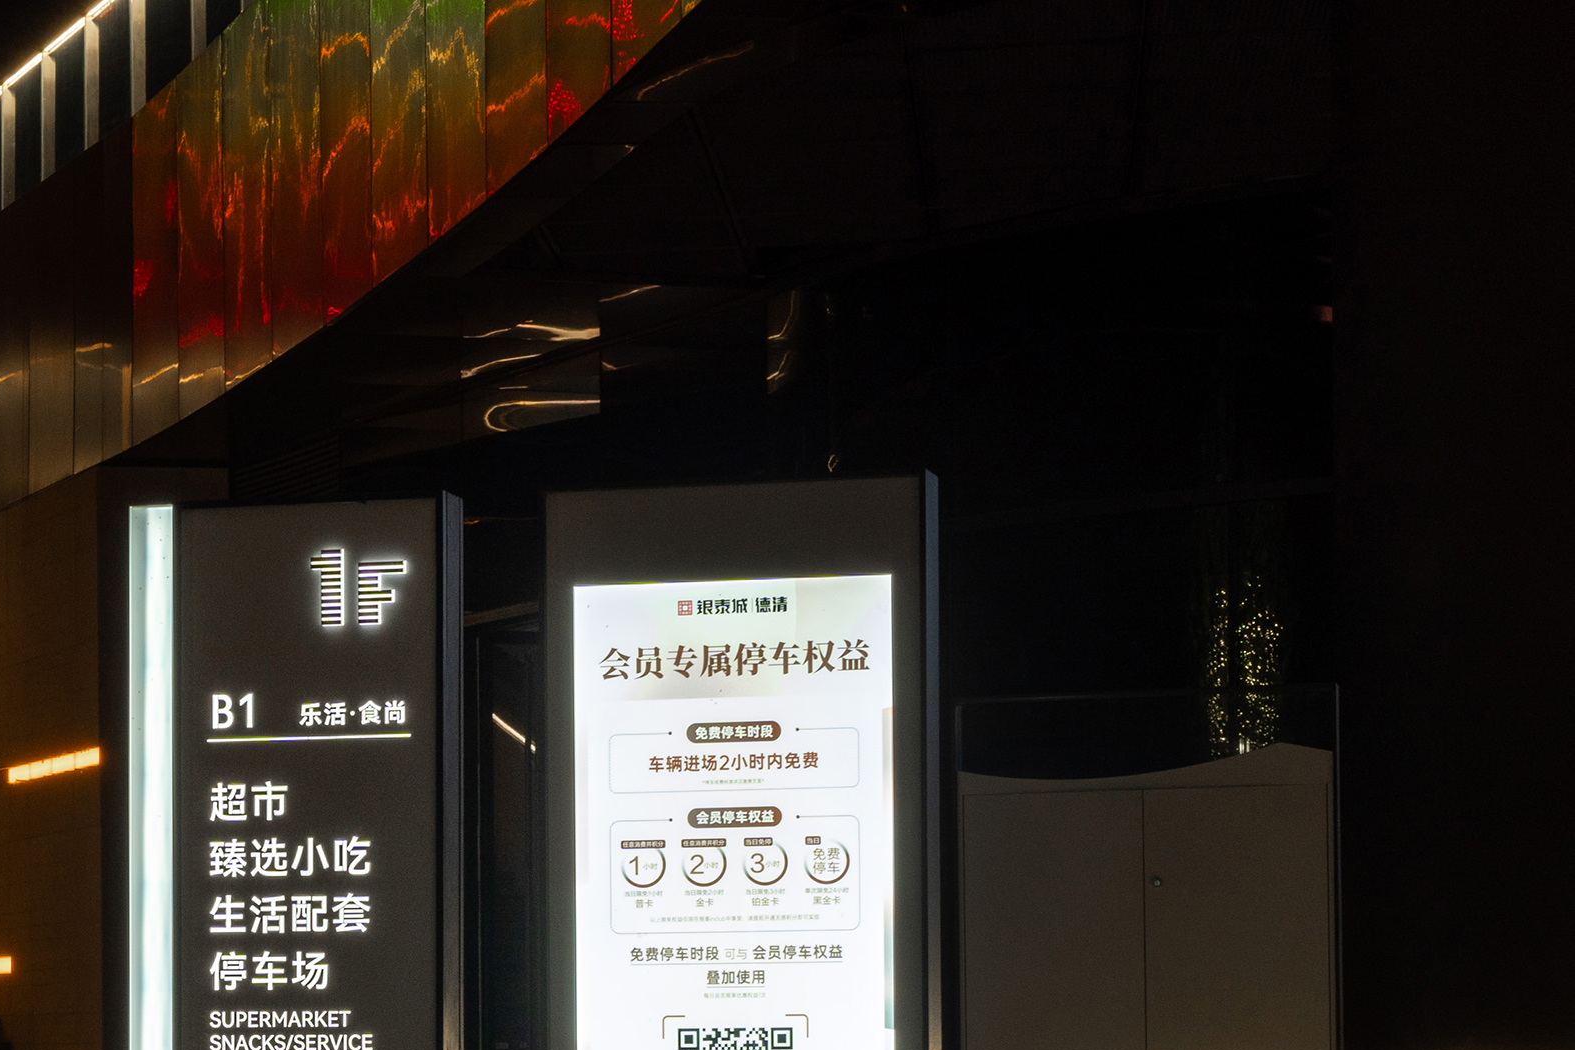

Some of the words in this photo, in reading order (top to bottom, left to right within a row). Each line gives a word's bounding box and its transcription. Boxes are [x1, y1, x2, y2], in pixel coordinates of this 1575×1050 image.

[309, 547, 408, 628] 1F
[696, 597, 748, 615] 银泰城
[755, 596, 788, 614] 德清
[599, 638, 870, 681] 会员专属停车权益
[211, 692, 254, 730] B1
[298, 699, 407, 727] 乐活·食尚
[694, 724, 774, 741] 免费停车时段
[648, 751, 819, 773] 车辆进场2小时内免费
[209, 780, 289, 822] 超市
[695, 809, 775, 825] 会员停车权益
[208, 835, 372, 878] 臻选小吃
[813, 847, 840, 860] 免费
[813, 861, 840, 874] 停车
[696, 898, 713, 907] 金卡
[813, 896, 841, 905] 黑金卡
[208, 892, 372, 935] 生活配套
[629, 946, 720, 962] 免费停车时段
[724, 948, 748, 961] 可与
[751, 944, 843, 960] 会员停车权益
[208, 950, 329, 992] 停车场
[706, 970, 766, 985] 叠加使用
[209, 1009, 352, 1029] SUPERMARKET
